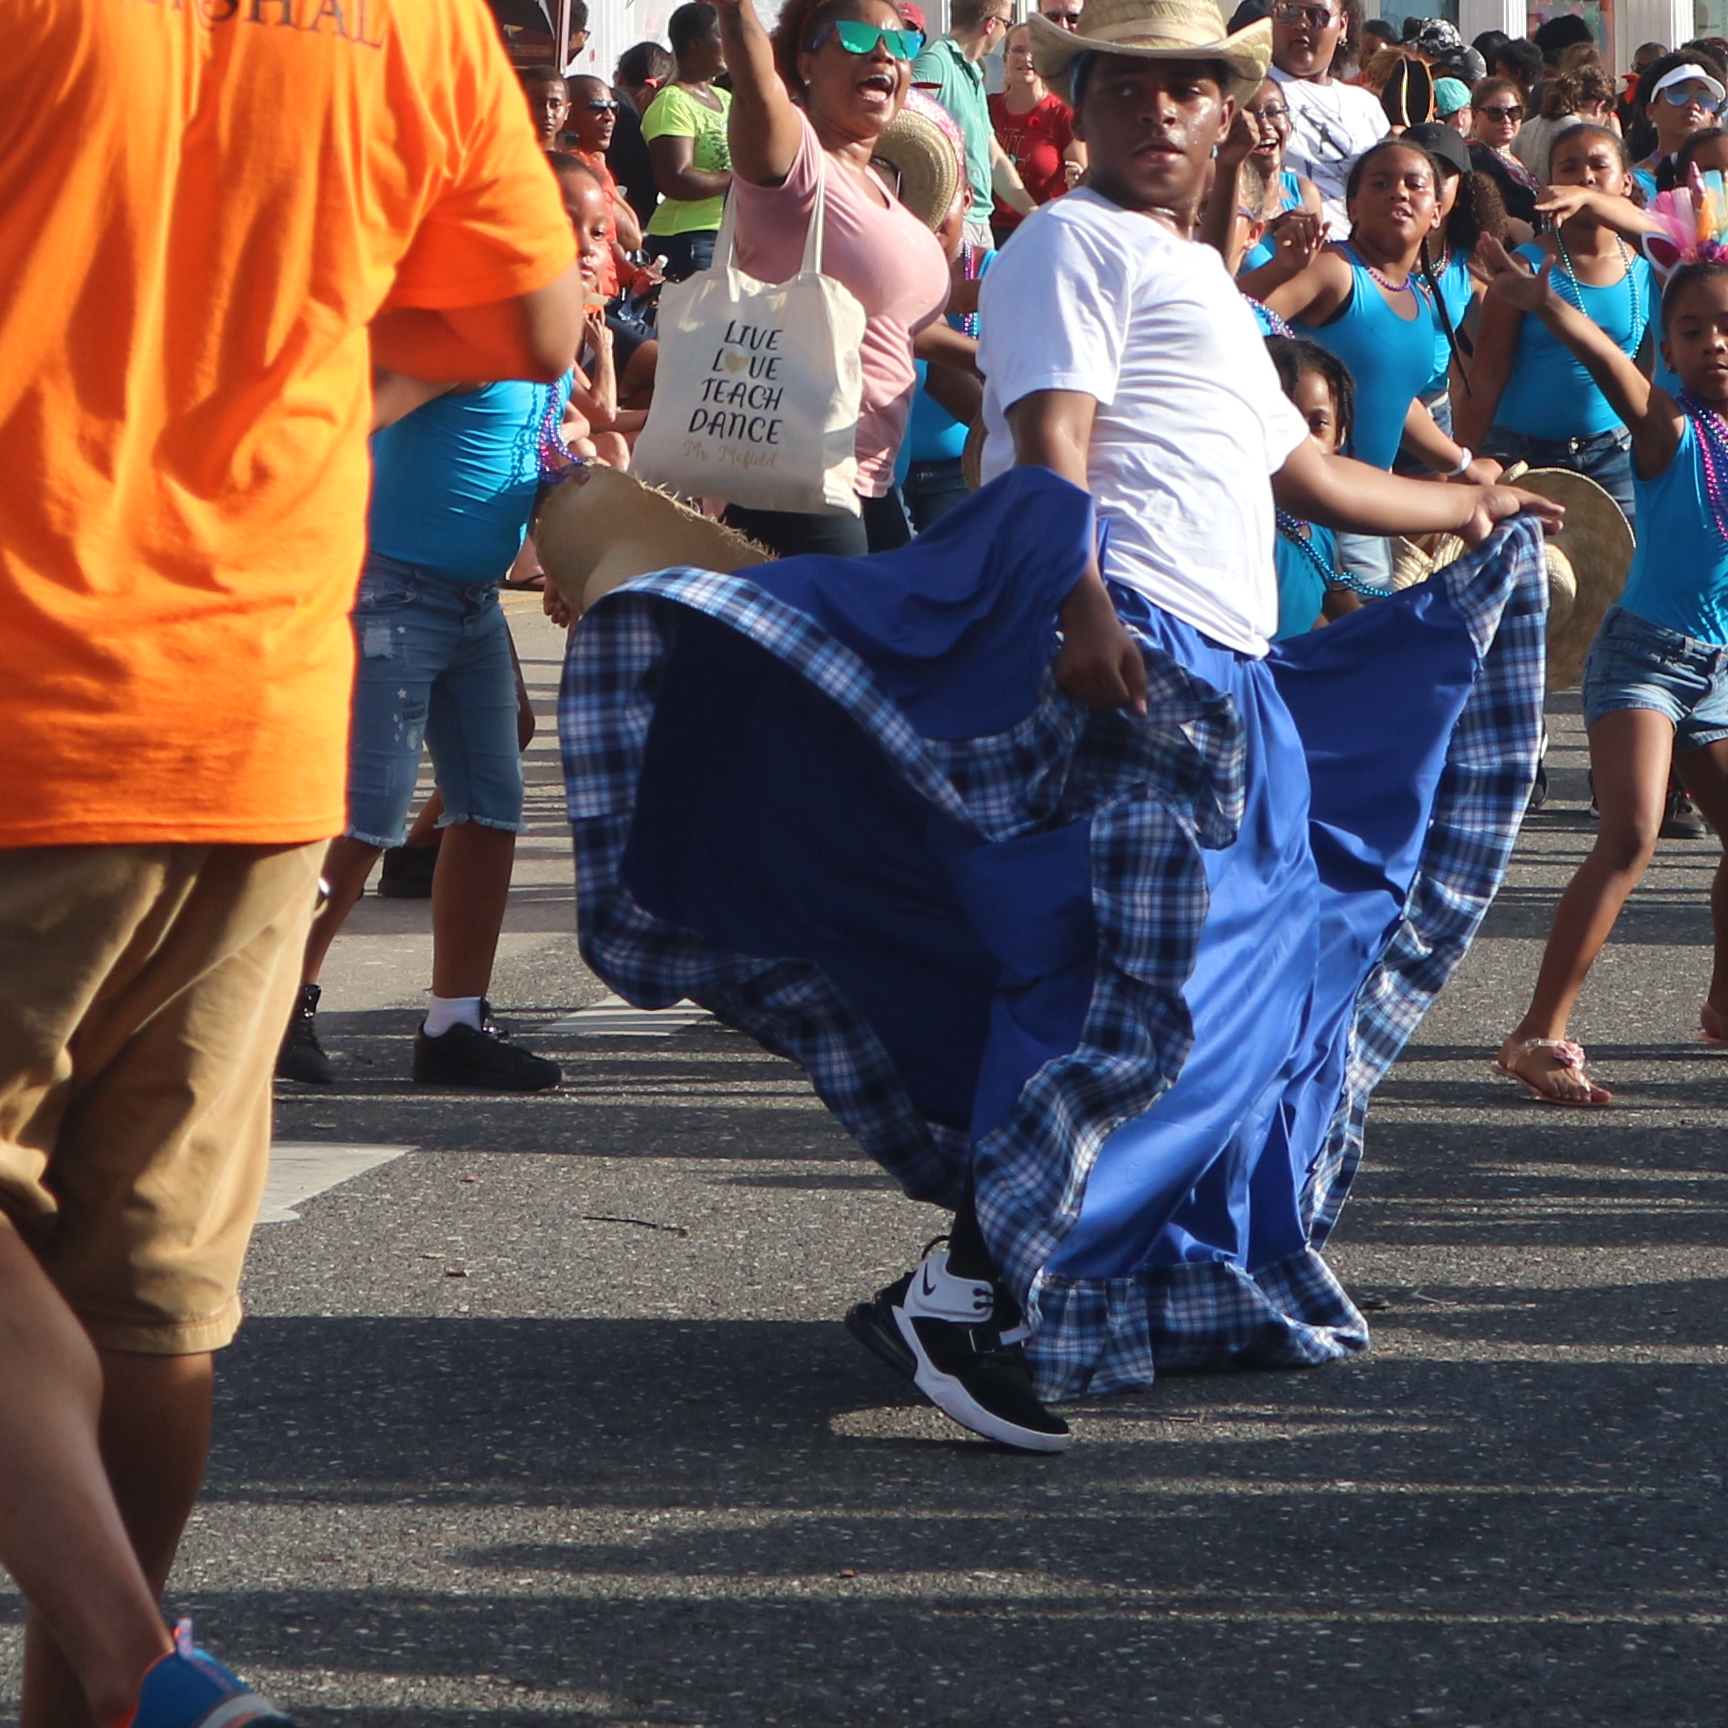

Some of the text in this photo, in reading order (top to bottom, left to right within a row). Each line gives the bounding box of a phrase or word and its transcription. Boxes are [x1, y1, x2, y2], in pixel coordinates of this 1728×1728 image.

[725, 320, 783, 351] LIVE
[702, 377, 784, 411] TEACH
[688, 408, 784, 444] DANCE
